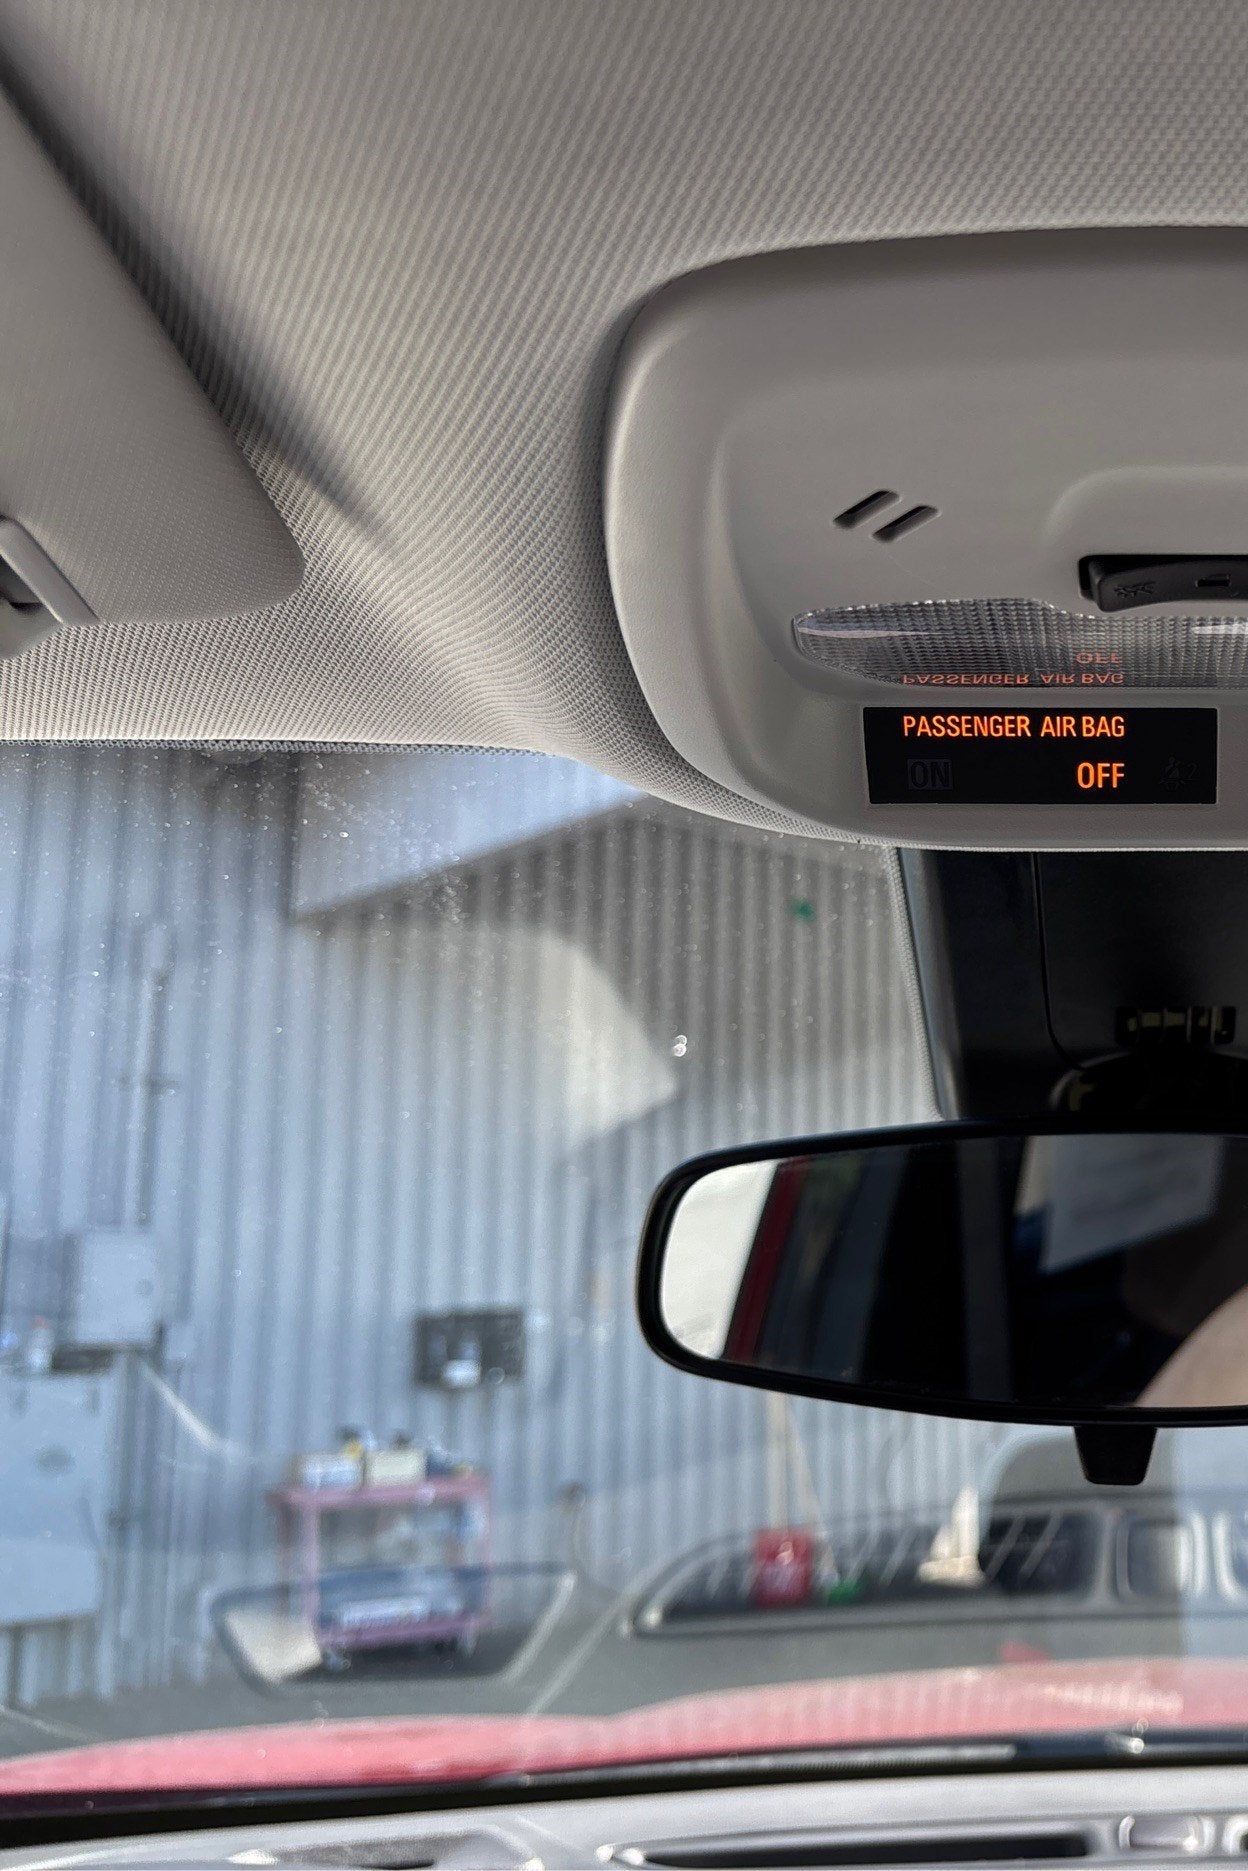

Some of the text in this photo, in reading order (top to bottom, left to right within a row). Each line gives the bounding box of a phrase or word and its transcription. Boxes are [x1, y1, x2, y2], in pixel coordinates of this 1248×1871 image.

[903, 715, 1126, 738] PASSENGER AIR BAG
[910, 760, 950, 788] ON
[1076, 762, 1126, 789] OFF
